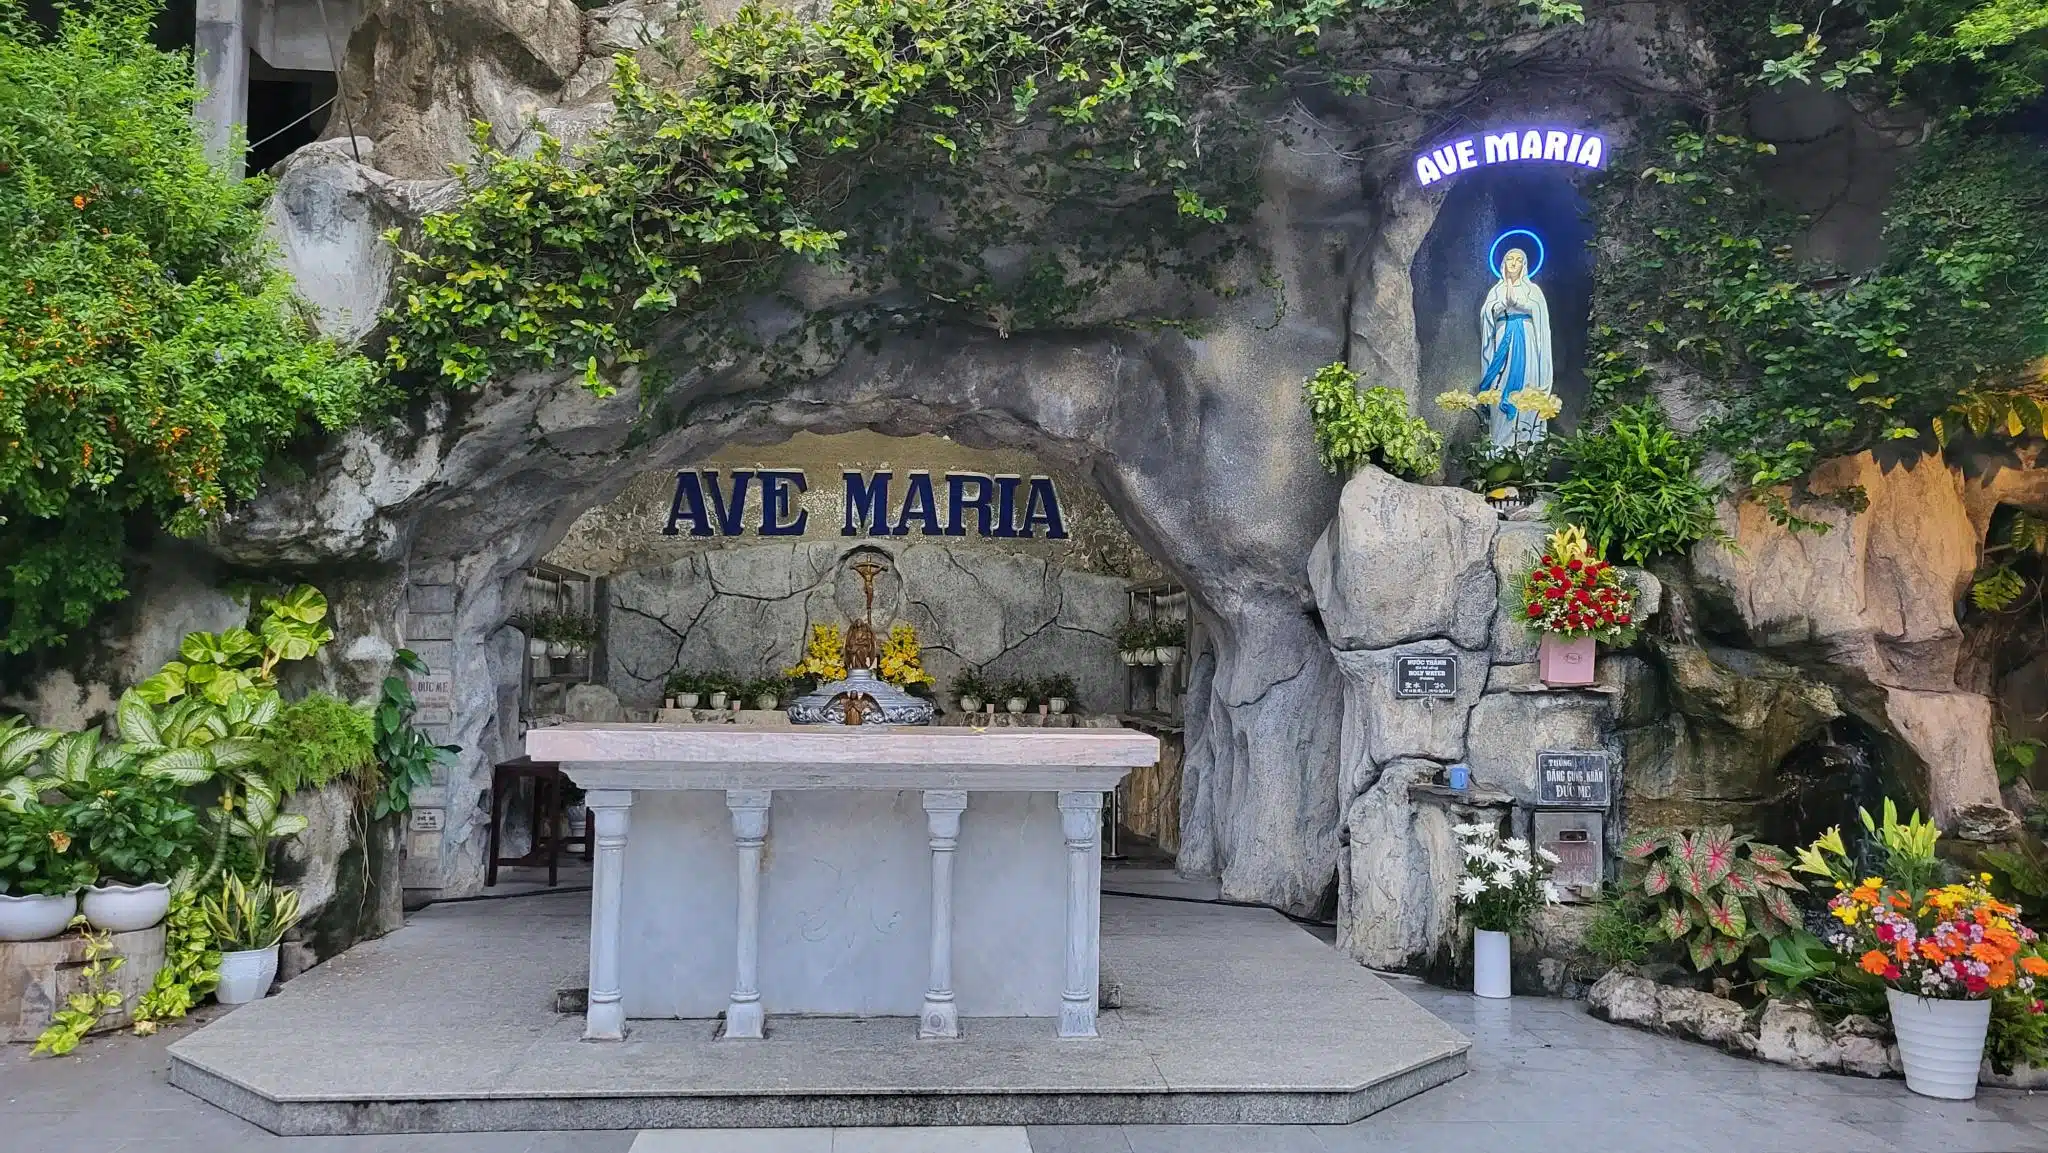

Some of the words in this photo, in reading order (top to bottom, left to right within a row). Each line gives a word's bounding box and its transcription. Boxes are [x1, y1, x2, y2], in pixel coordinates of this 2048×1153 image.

[1416, 139, 1478, 186] AVE
[1484, 130, 1602, 168] MARIA
[662, 469, 808, 536] AVE
[841, 469, 1069, 539] MARIA
